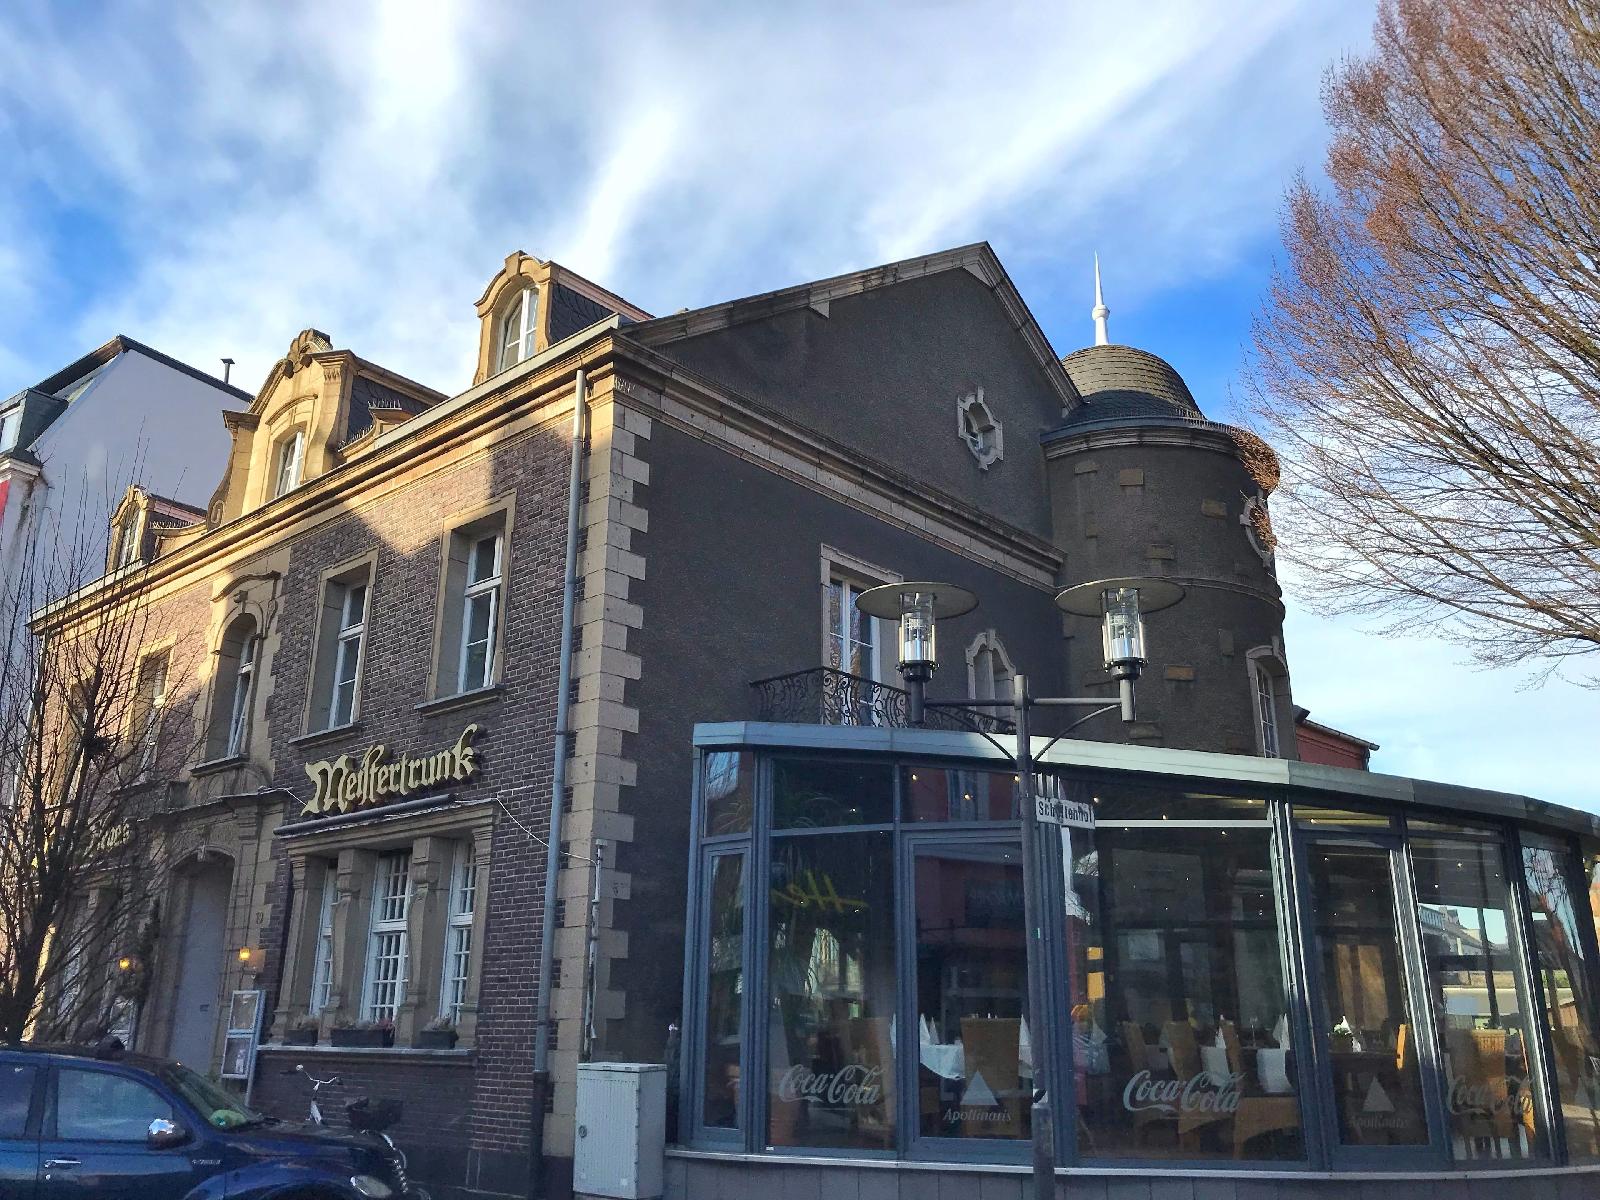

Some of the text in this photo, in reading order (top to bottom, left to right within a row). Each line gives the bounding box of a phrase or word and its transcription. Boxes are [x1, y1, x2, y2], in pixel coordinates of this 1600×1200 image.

[779, 1064, 884, 1104] Coca-Cola
[1123, 1069, 1247, 1112] Coca-Cola
[943, 1108, 1012, 1124] Apollinaris
